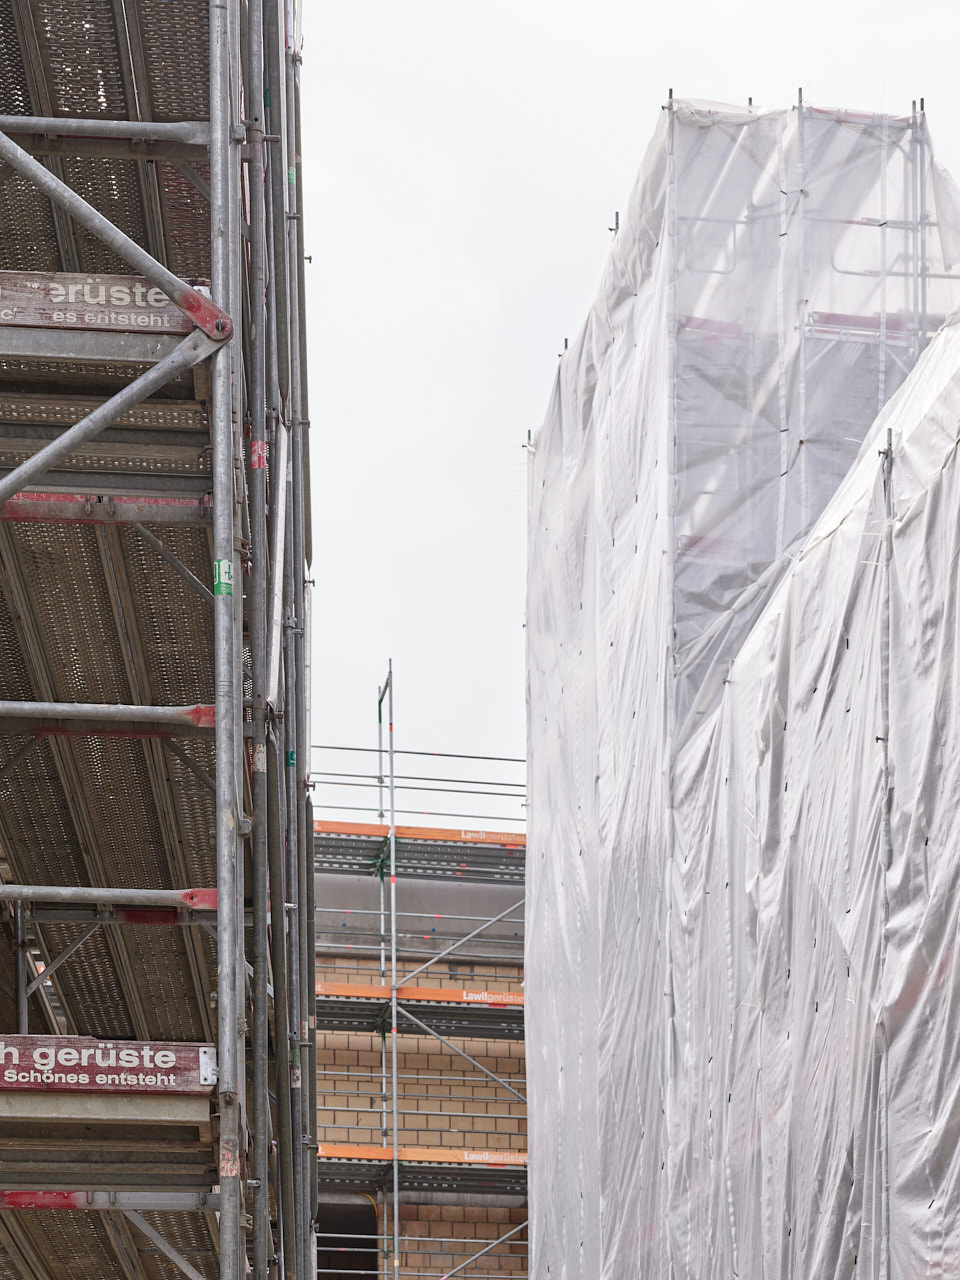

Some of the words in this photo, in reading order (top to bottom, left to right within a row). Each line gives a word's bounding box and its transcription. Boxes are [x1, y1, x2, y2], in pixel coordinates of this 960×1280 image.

[84, 311, 170, 327] entsteht
[32, 1042, 177, 1071] gerüste
[4, 1069, 90, 1084] Schönes
[95, 1072, 176, 1087] entsteht
